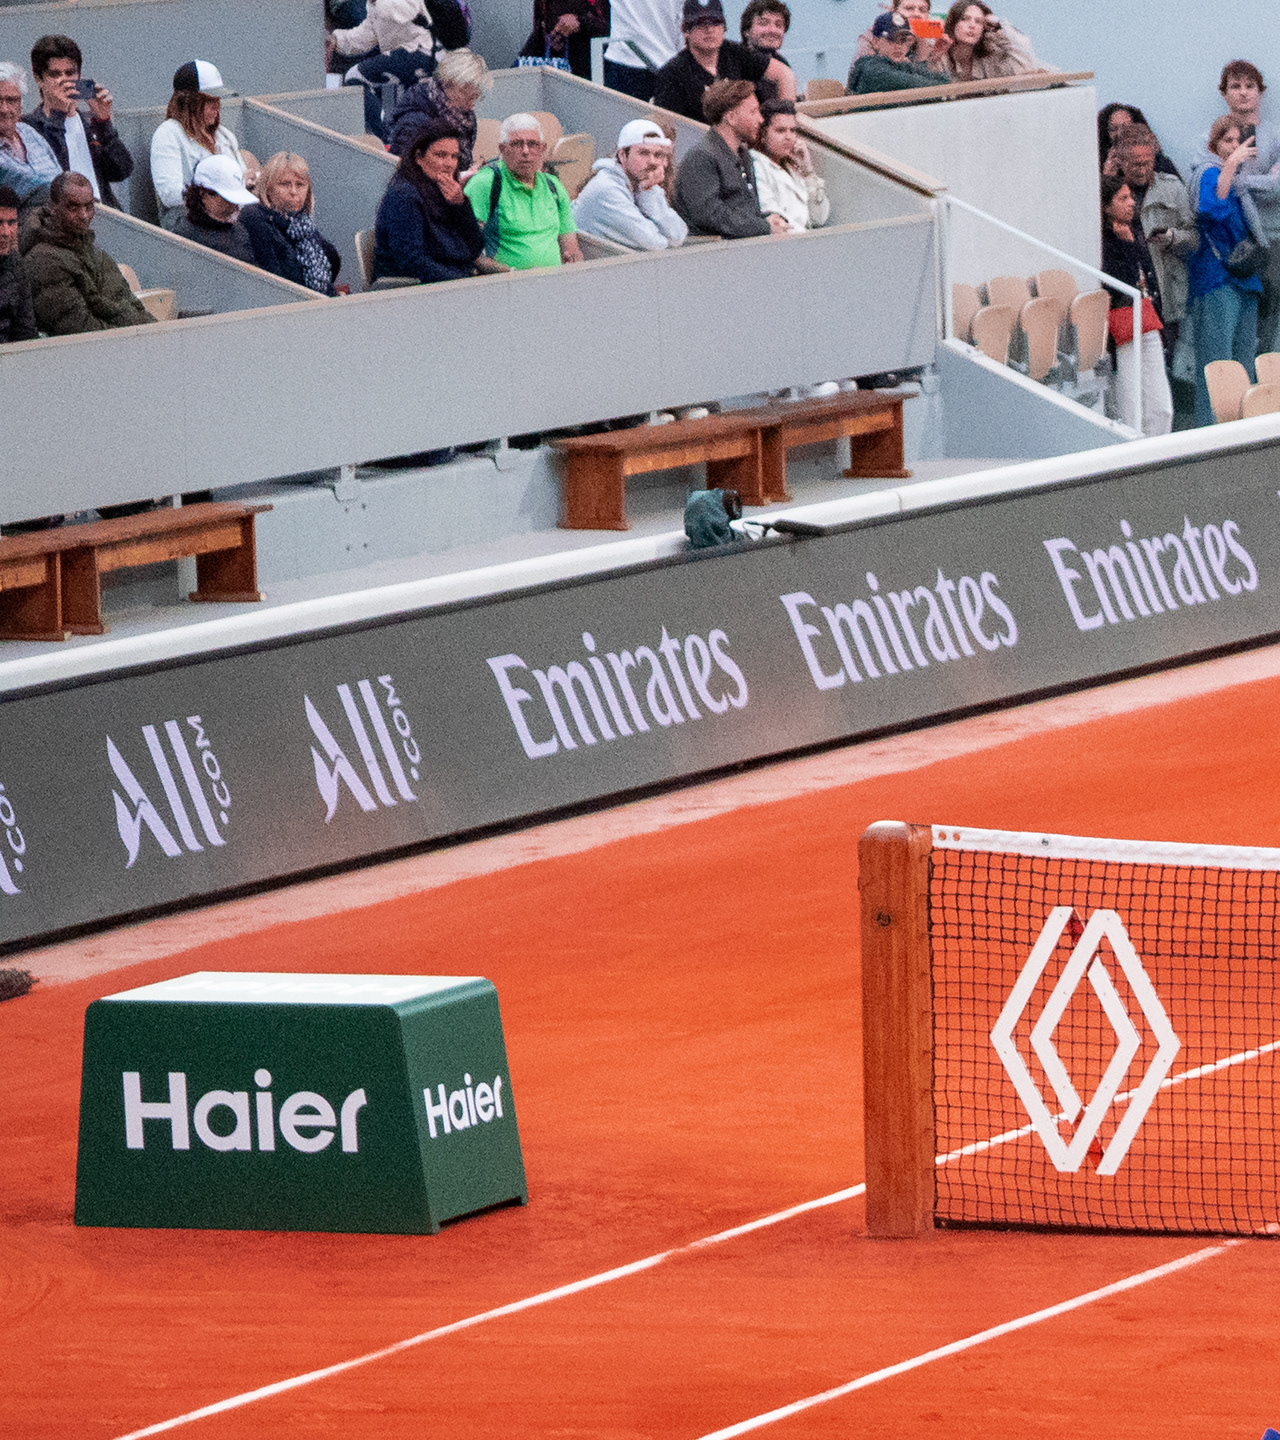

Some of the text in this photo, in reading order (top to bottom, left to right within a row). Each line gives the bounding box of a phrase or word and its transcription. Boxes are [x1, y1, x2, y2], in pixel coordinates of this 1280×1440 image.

[780, 569, 1017, 690] Emirates
[1043, 517, 1258, 631] Emirates
[487, 627, 749, 758] Emirates
[123, 1069, 367, 1152] Haier
[424, 1073, 503, 1138] Haier
